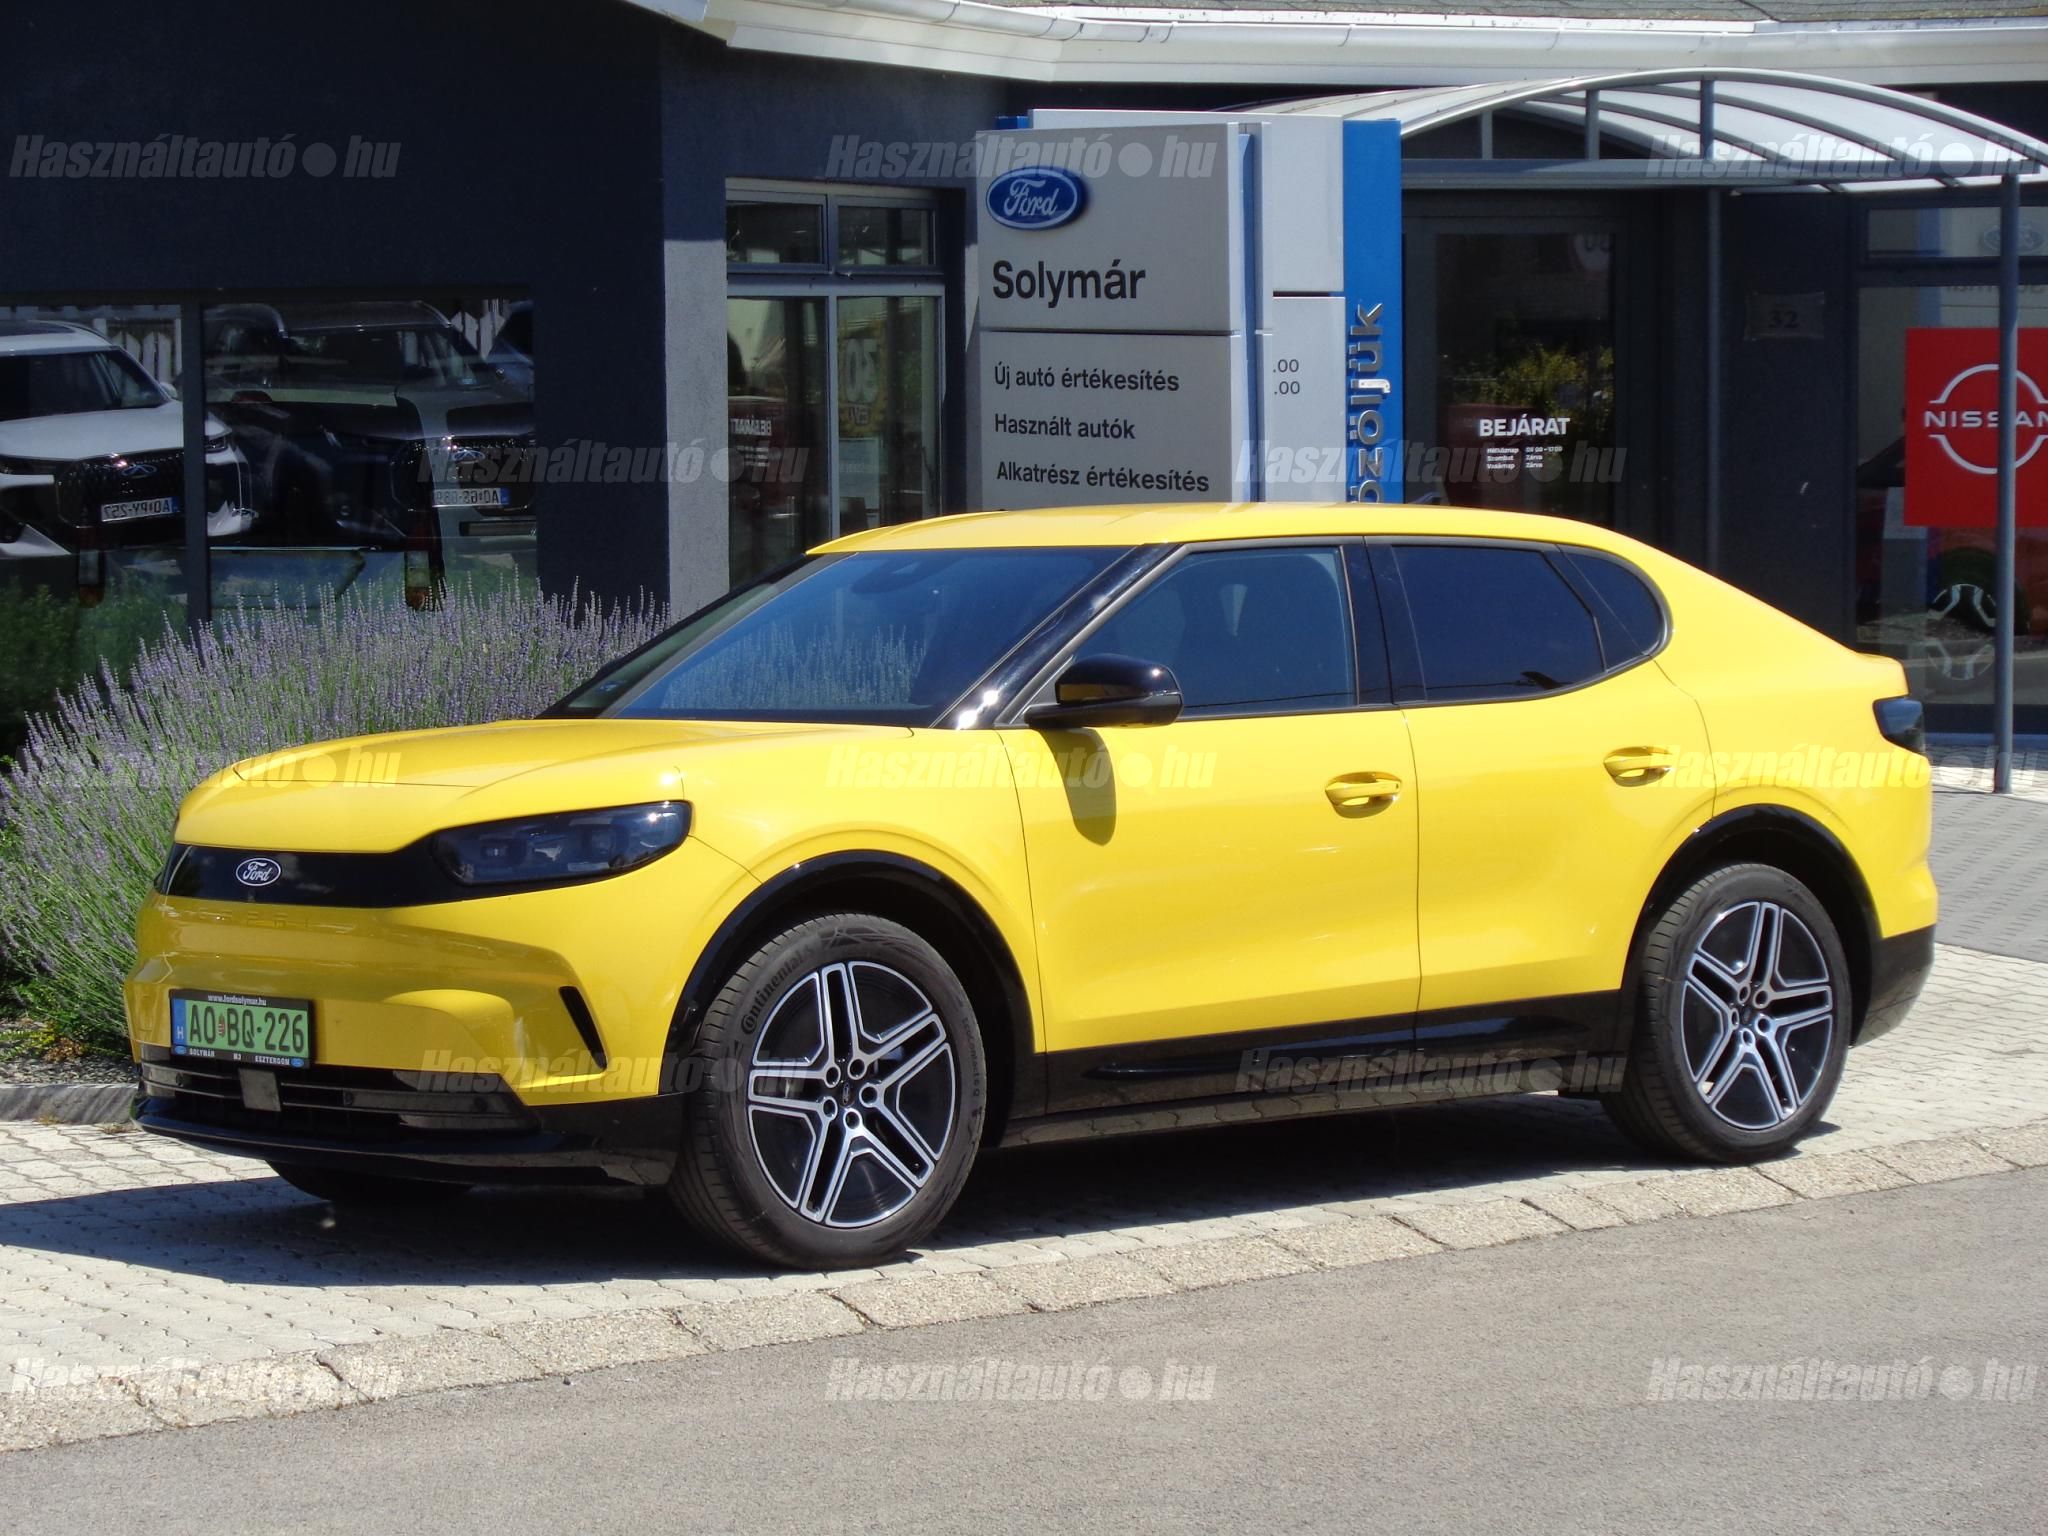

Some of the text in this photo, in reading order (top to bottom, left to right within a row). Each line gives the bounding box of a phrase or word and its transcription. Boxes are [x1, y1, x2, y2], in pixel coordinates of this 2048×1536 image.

[1003, 178, 1060, 217] Ford
[993, 258, 1146, 309] Solymár
[994, 361, 1180, 392] Új autó értékesítés
[994, 413, 1136, 439] Használt autók
[1479, 413, 1571, 437] BEJÁRAT
[996, 461, 1210, 493] Alkatrész értékesítés
[242, 861, 273, 882] Ford
[176, 1025, 185, 1040] H
